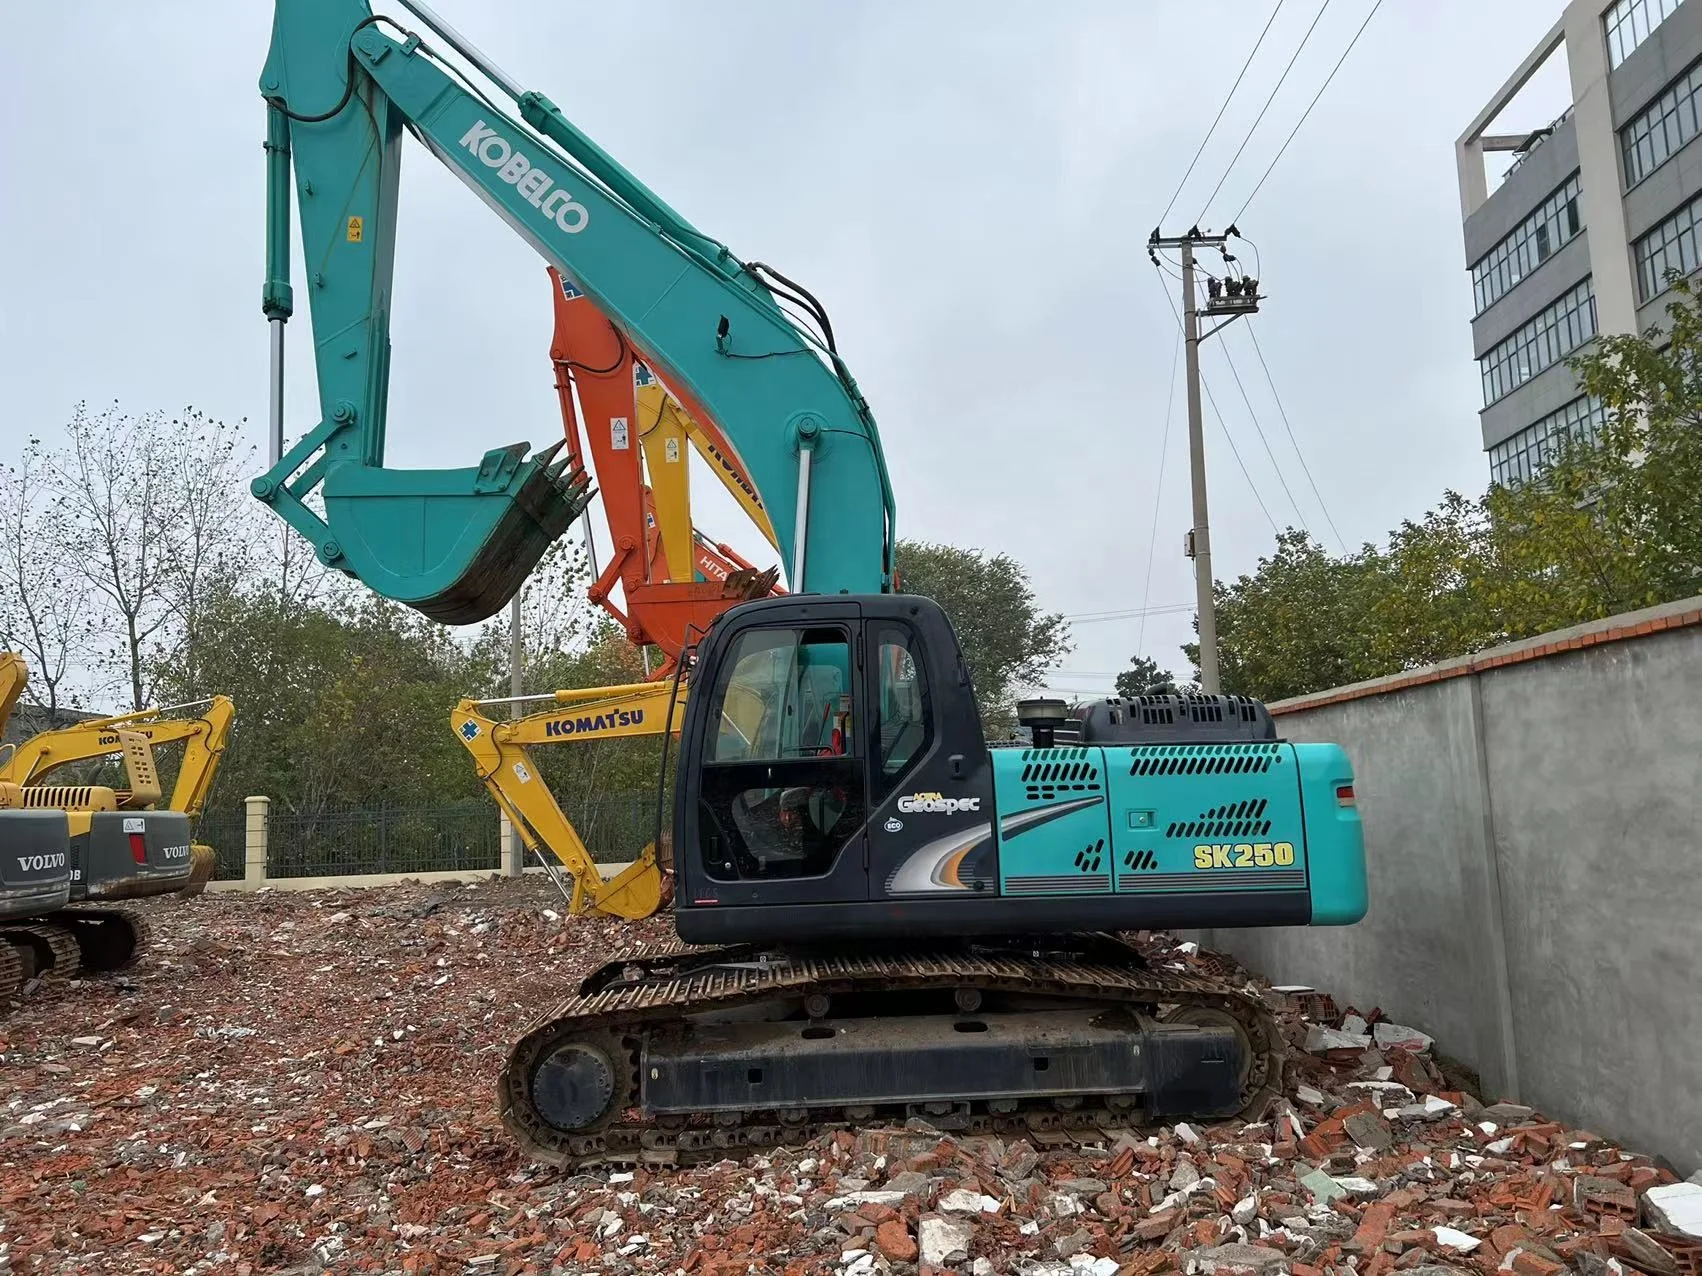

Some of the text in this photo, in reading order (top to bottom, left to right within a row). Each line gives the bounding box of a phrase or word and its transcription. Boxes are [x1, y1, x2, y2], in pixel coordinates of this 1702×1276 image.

[458, 119, 589, 234] KOBELCO
[700, 556, 728, 581] HITA
[546, 708, 644, 737] KOMATSU
[887, 822, 901, 830] ECO
[17, 852, 65, 871] VOLVO
[1193, 842, 1295, 869] SK250
